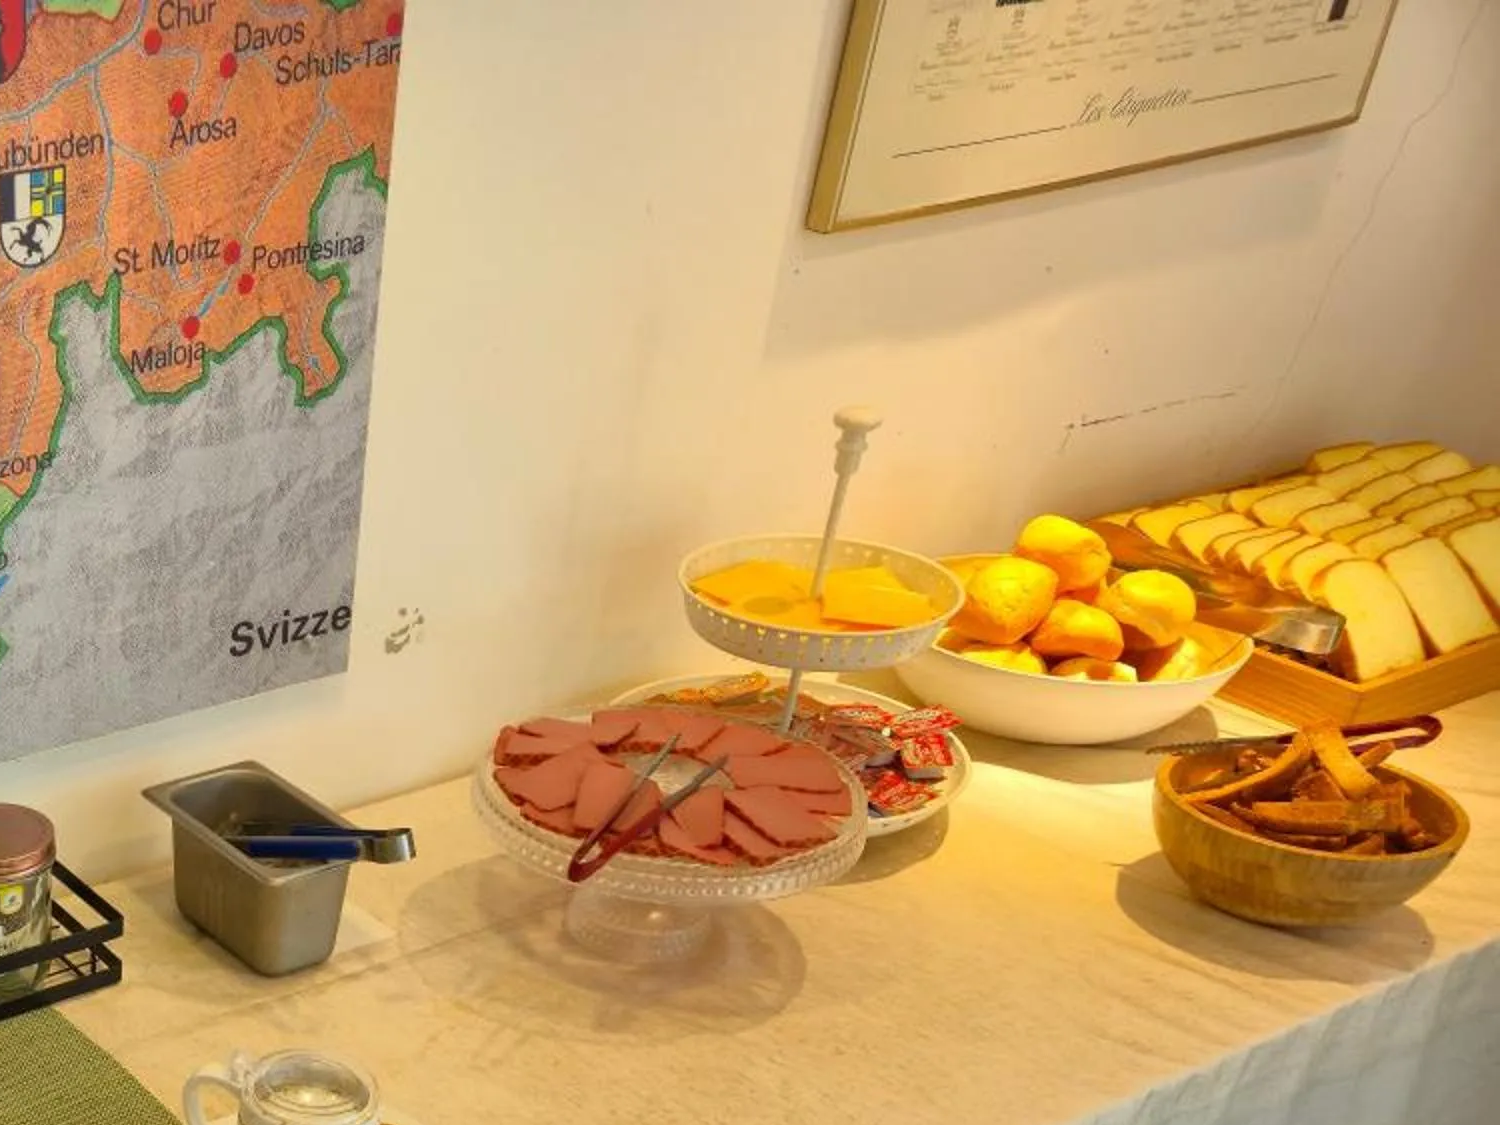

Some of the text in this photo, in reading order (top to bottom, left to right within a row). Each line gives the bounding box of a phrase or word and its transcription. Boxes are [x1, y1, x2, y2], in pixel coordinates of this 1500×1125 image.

[157, 0, 216, 31] Chur
[233, 21, 305, 53] Davos
[169, 117, 237, 149] Arosa
[150, 235, 221, 268] Moritz
[251, 232, 367, 270] Pontresina
[130, 340, 206, 375] Maloja
[229, 605, 352, 657] Svizze
